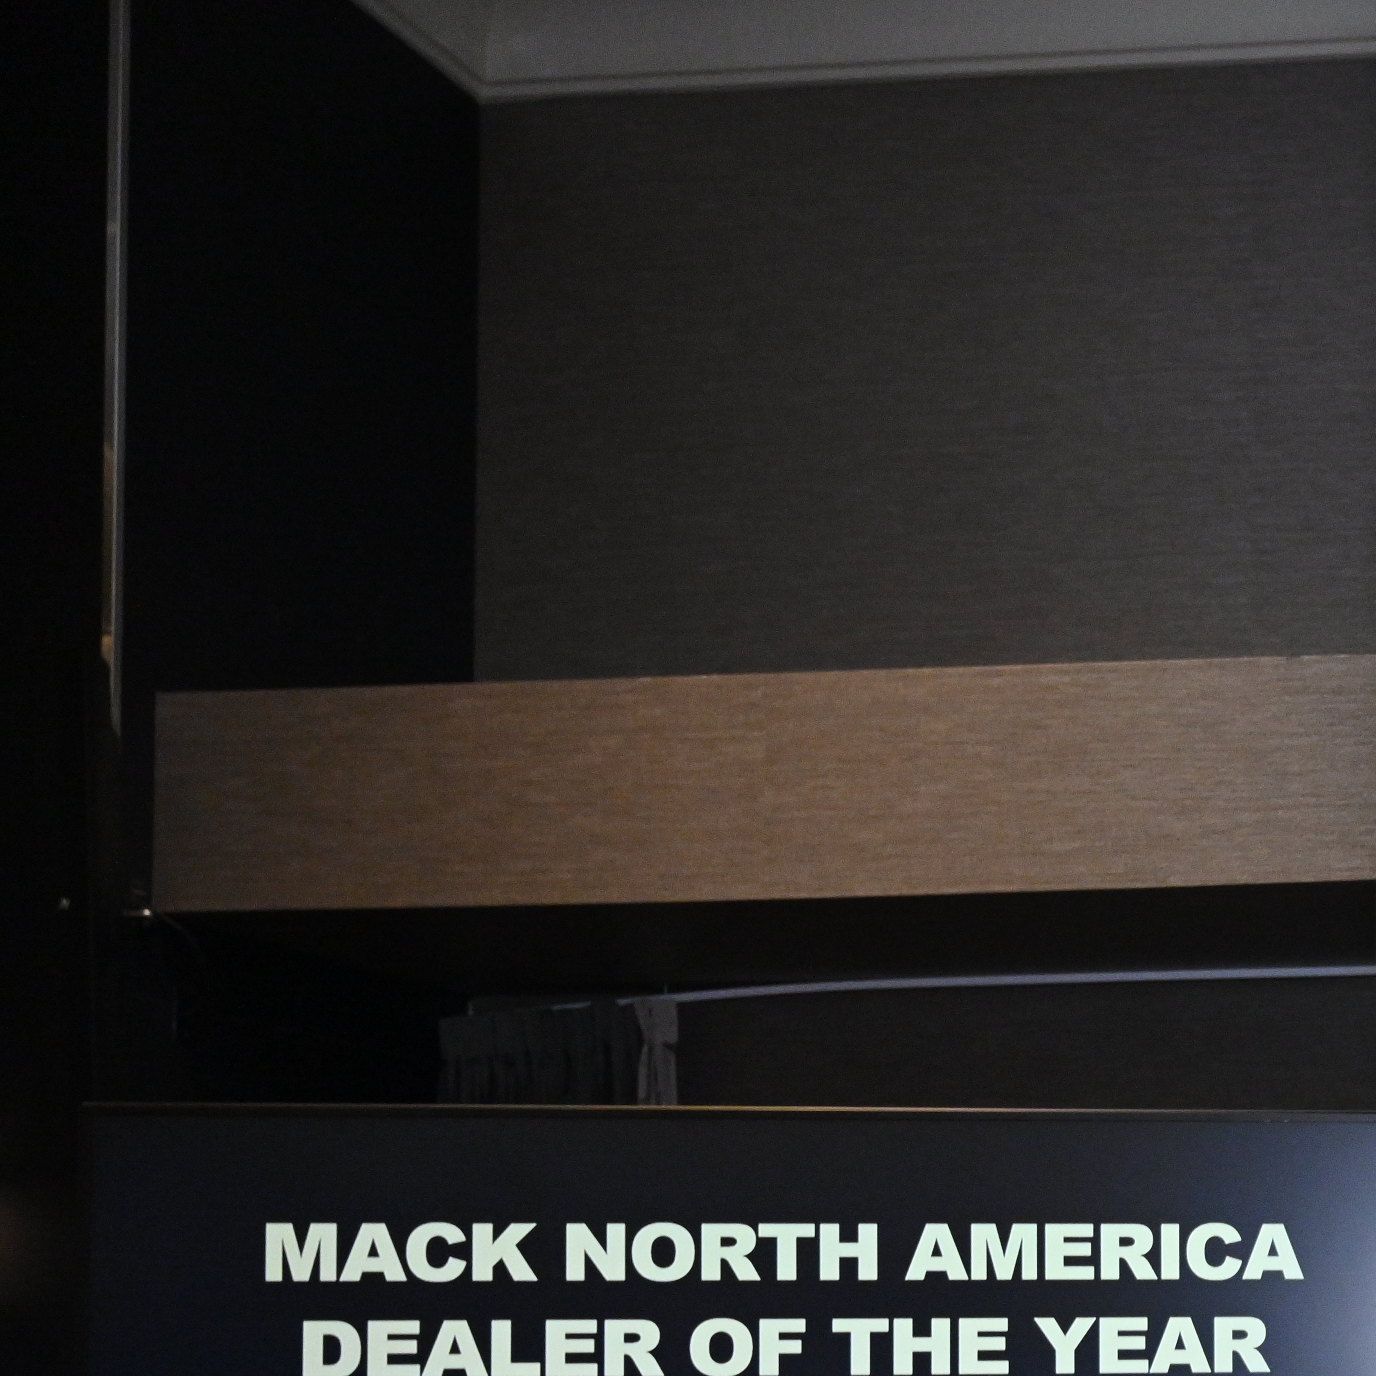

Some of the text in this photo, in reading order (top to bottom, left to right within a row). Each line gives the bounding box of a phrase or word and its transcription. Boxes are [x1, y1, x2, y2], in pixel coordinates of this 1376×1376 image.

[265, 1222, 1304, 1282] MACK NORTH AMERICA
[690, 1318, 806, 1376] OF
[832, 1318, 1009, 1376] THE
[1034, 1316, 1270, 1374] YEAR
